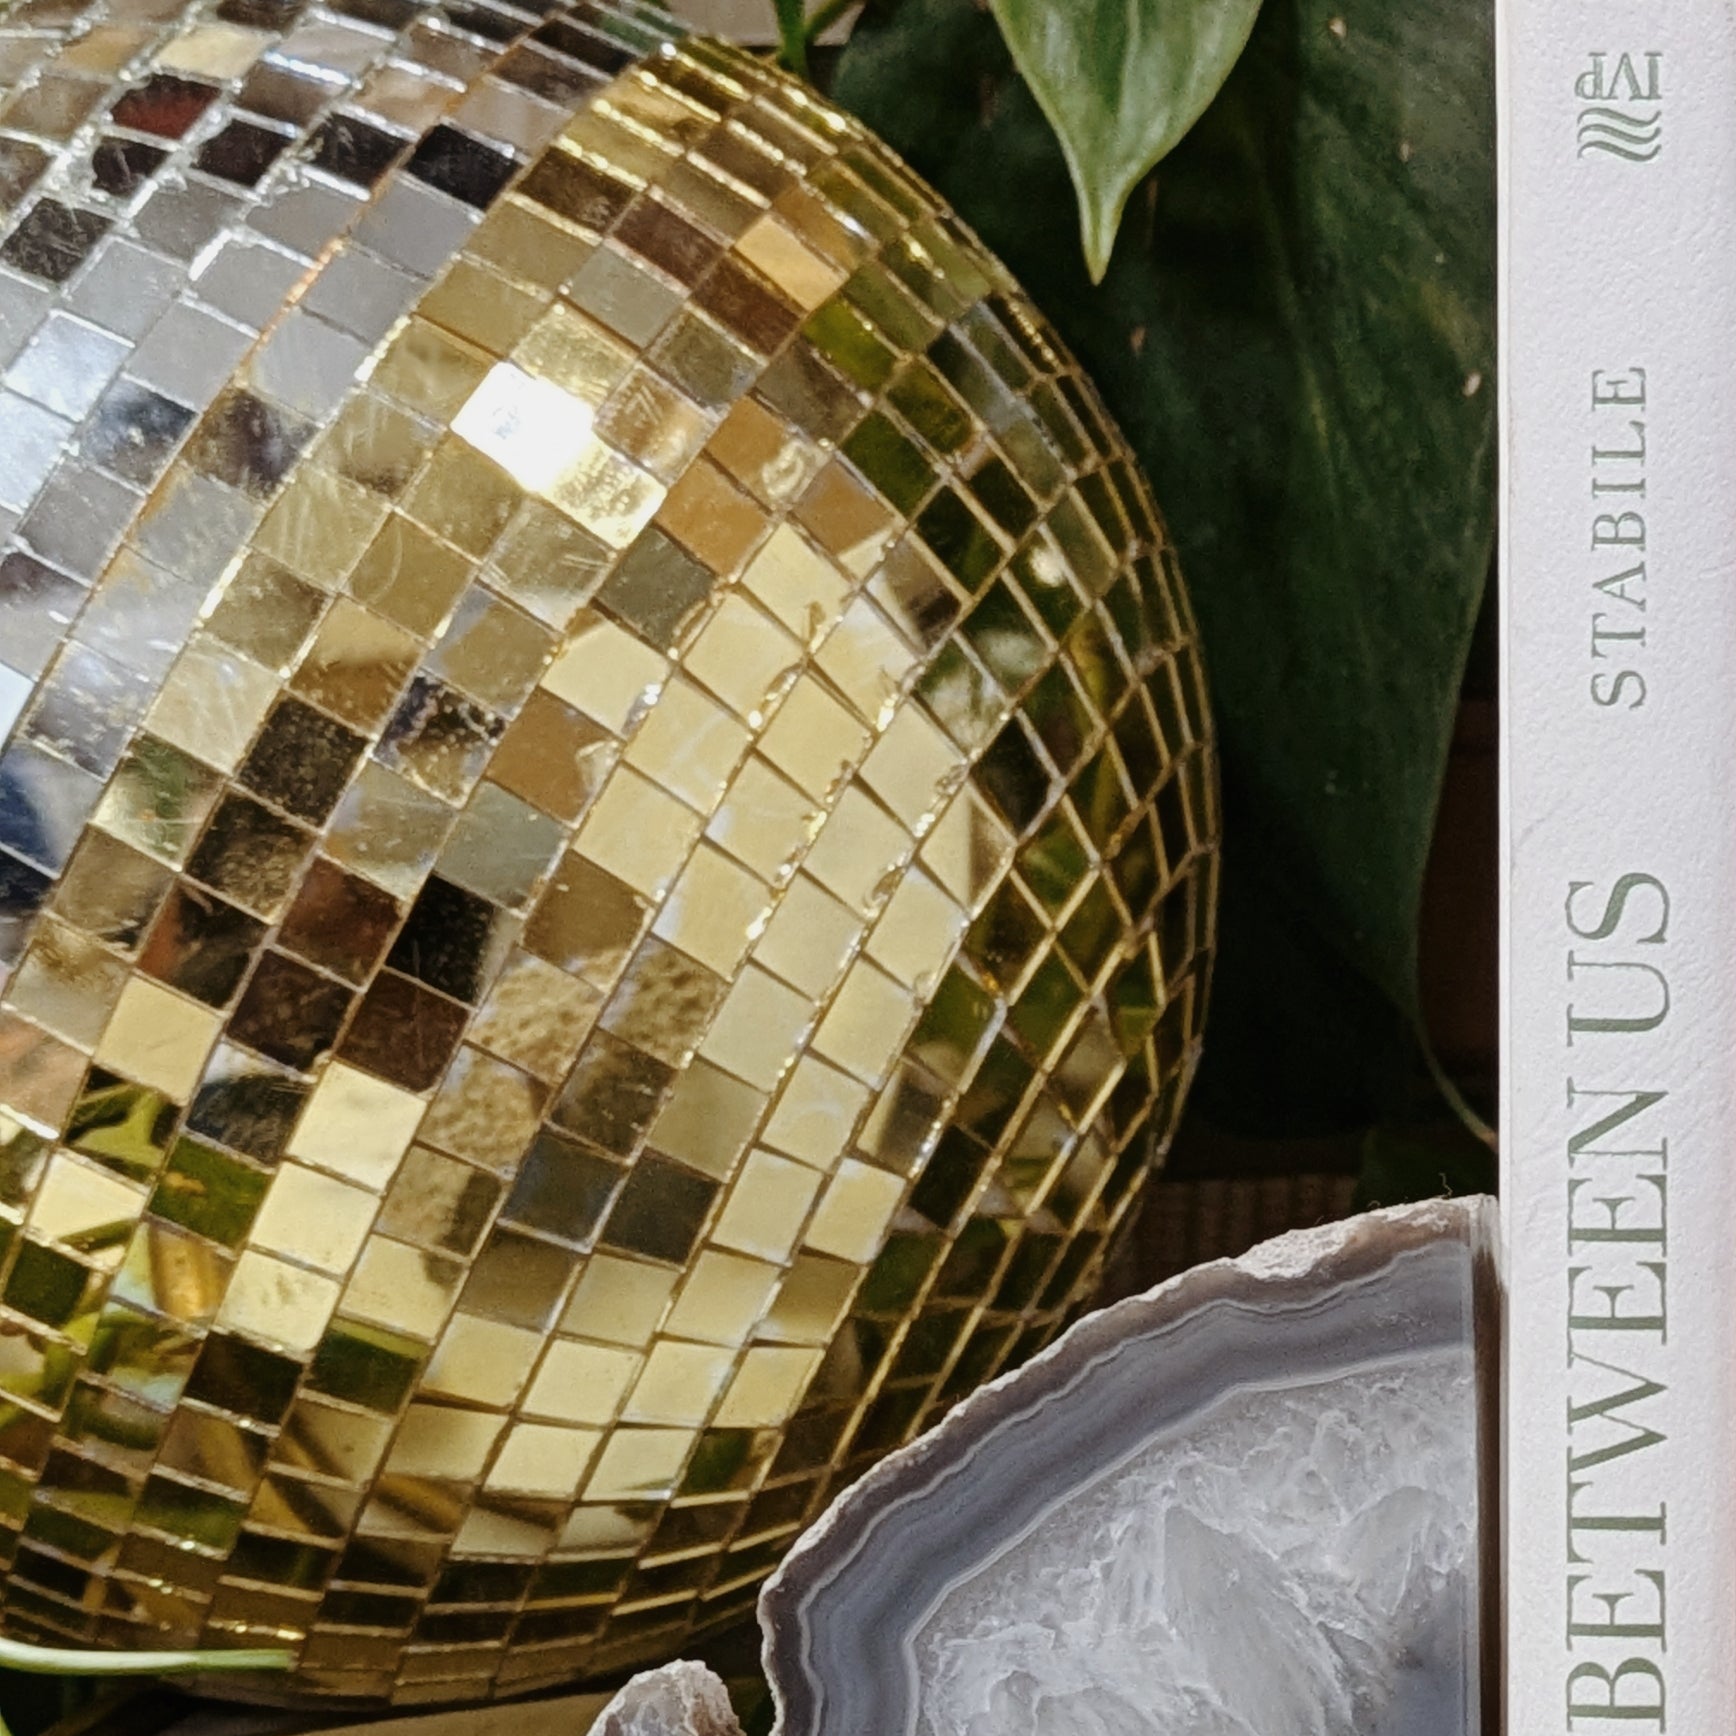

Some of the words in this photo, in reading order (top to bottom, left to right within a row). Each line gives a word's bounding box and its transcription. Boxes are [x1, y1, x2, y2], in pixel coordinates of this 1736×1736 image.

[1574, 51, 1664, 101] IVP
[1591, 366, 1649, 710] STABILE
[1564, 871, 1671, 1048] US
[1565, 1077, 1669, 1734] BETWEEN
